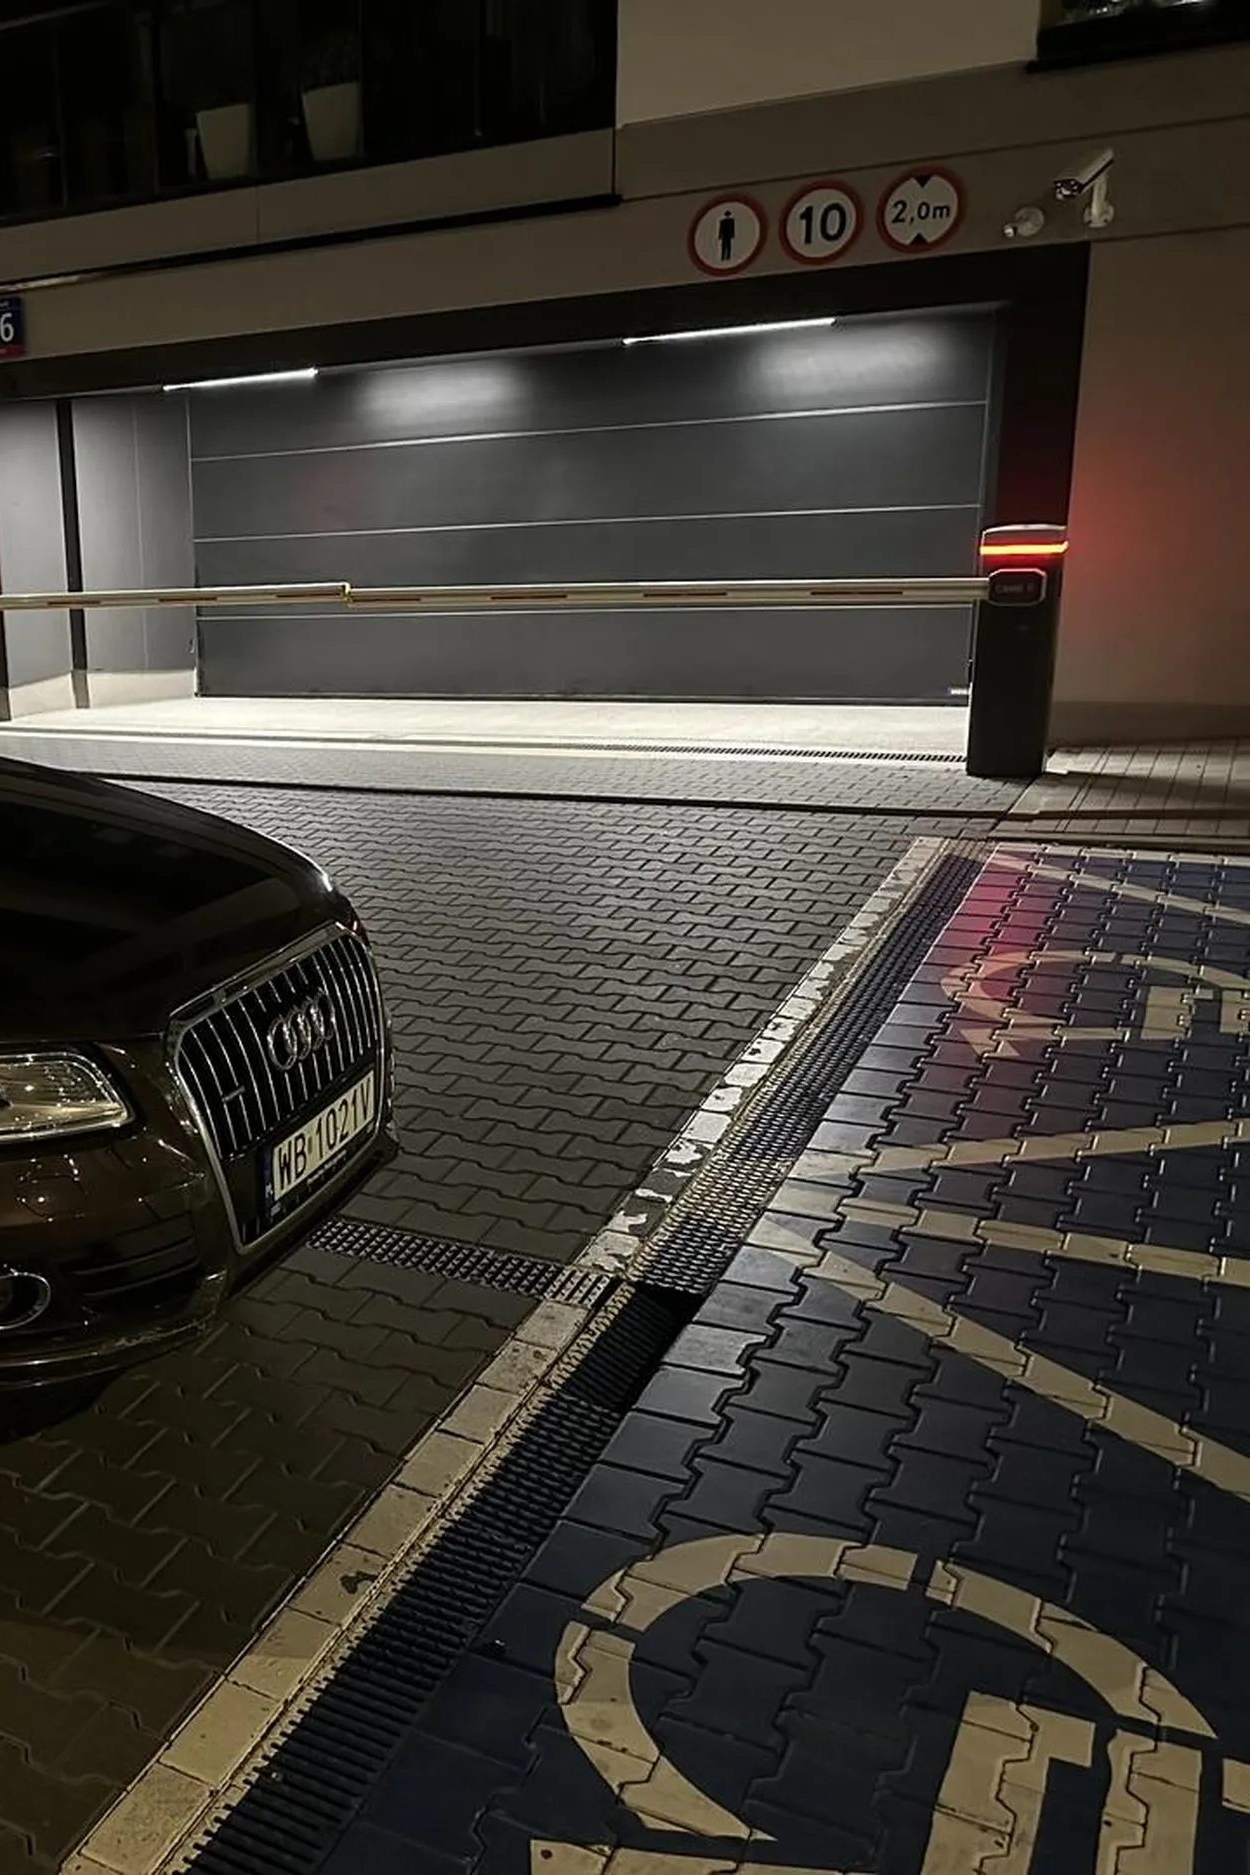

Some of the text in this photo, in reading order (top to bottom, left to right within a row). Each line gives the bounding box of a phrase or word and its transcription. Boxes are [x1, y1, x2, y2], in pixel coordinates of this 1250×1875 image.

[799, 202, 847, 245] 10
[890, 200, 951, 226] 2,0m
[277, 1131, 307, 1192] WB
[315, 1076, 372, 1160] 1021V
